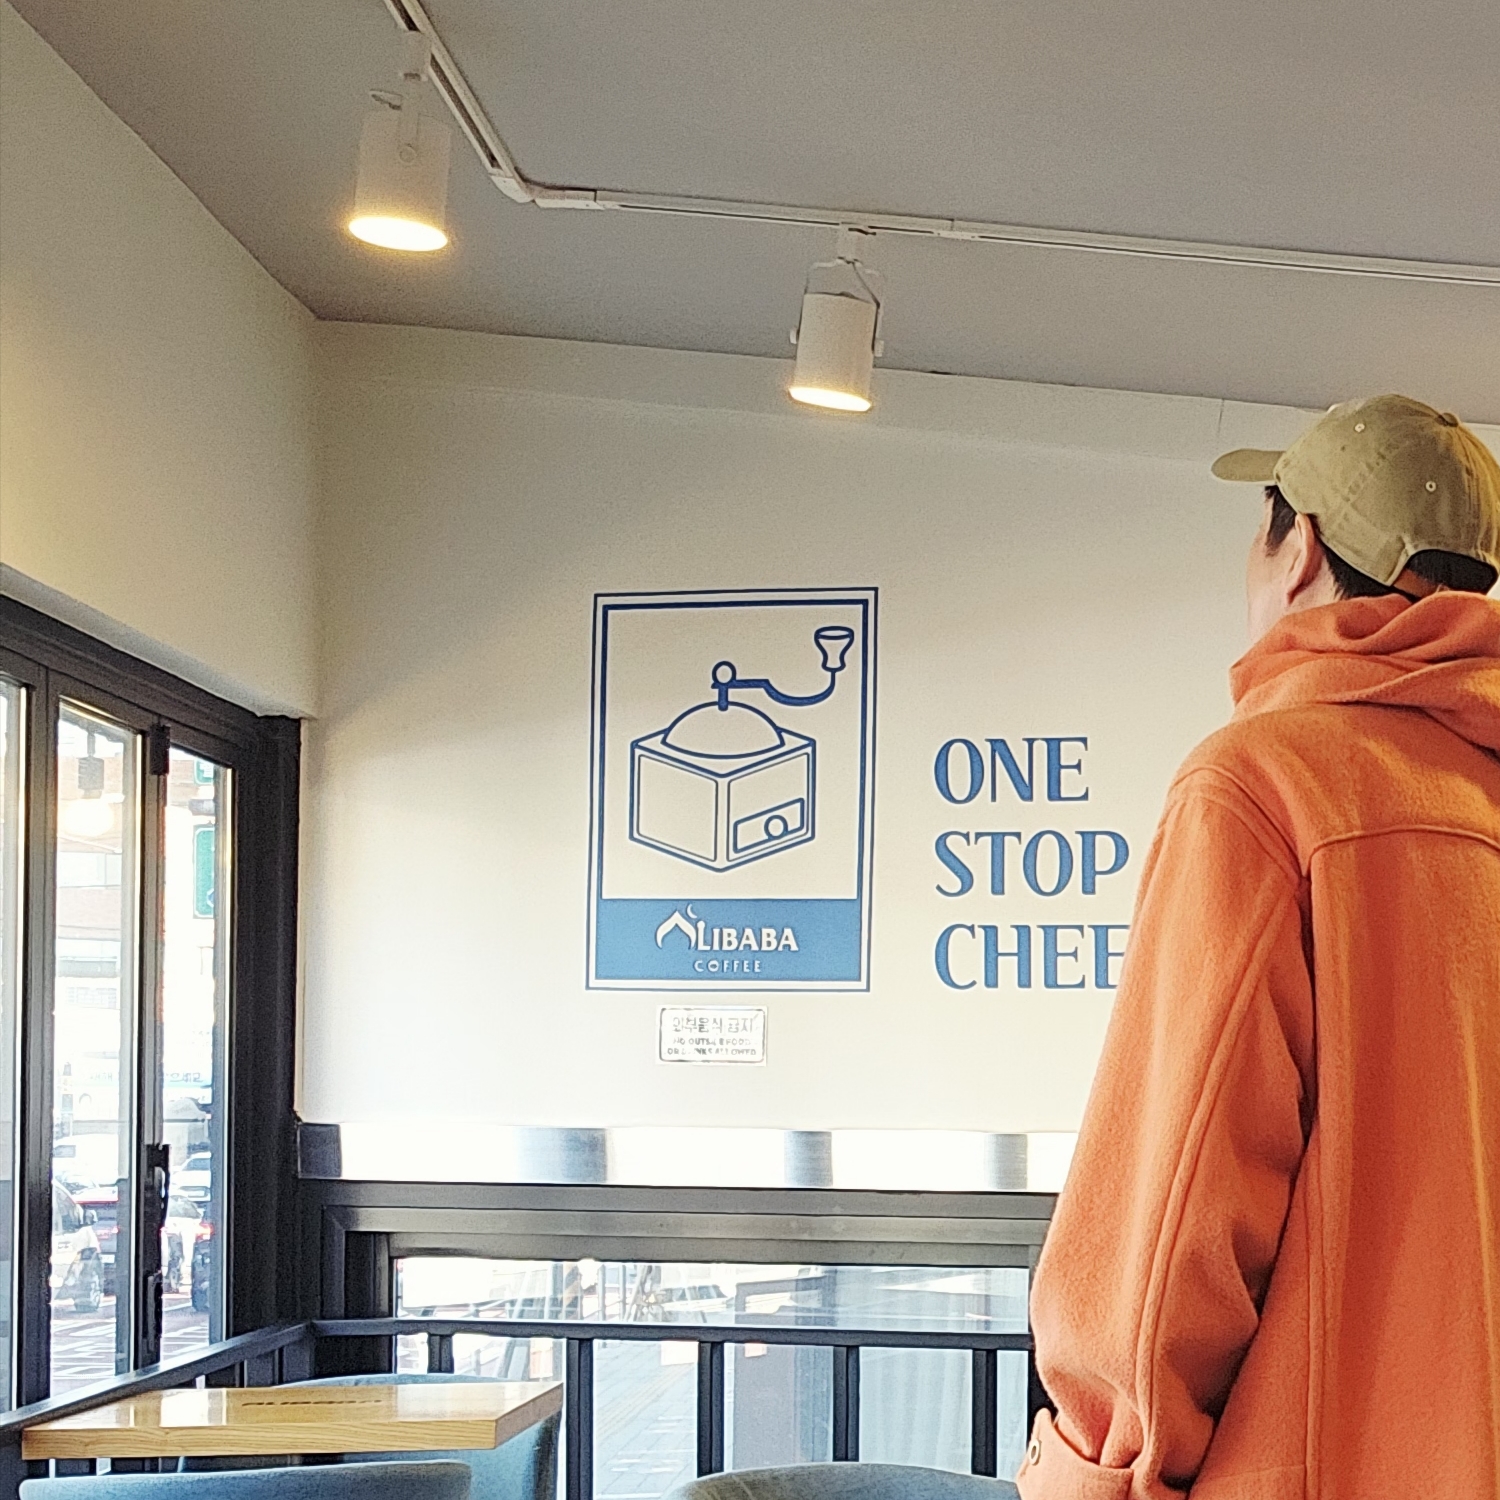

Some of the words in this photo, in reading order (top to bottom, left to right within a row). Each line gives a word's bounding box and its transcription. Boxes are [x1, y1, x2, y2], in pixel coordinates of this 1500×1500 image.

[934, 737, 1089, 804] ONE
[935, 830, 1130, 897] STOP
[694, 960, 762, 973] COFFEE
[935, 924, 1131, 990] CHEE
